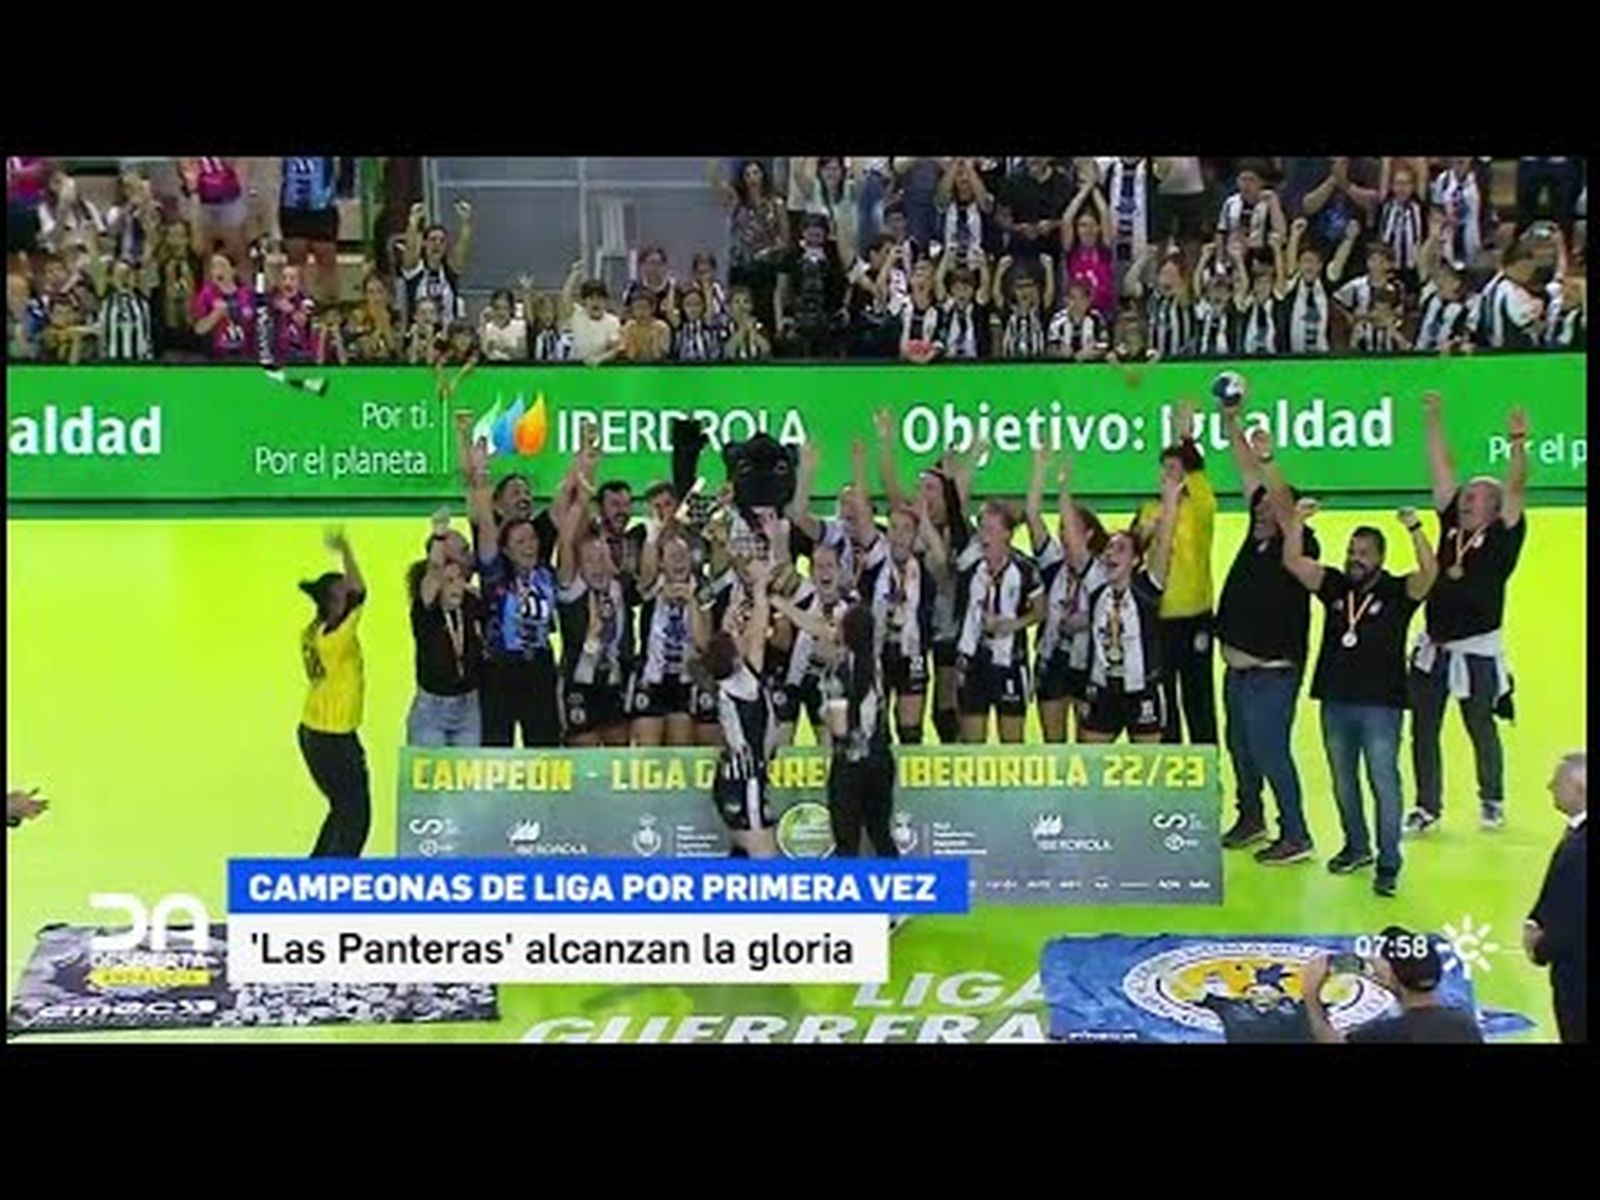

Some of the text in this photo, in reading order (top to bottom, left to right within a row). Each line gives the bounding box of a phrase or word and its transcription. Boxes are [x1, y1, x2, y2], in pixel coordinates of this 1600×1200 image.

[362, 400, 435, 430] Por ti.
[902, 400, 1144, 467] Objetivo:
[1540, 433, 1565, 464] el
[255, 446, 297, 475] Por
[303, 445, 326, 475] el
[412, 755, 572, 792] CAMPEÓN
[612, 759, 687, 791] LIGA
[1102, 754, 1206, 788] 22/23
